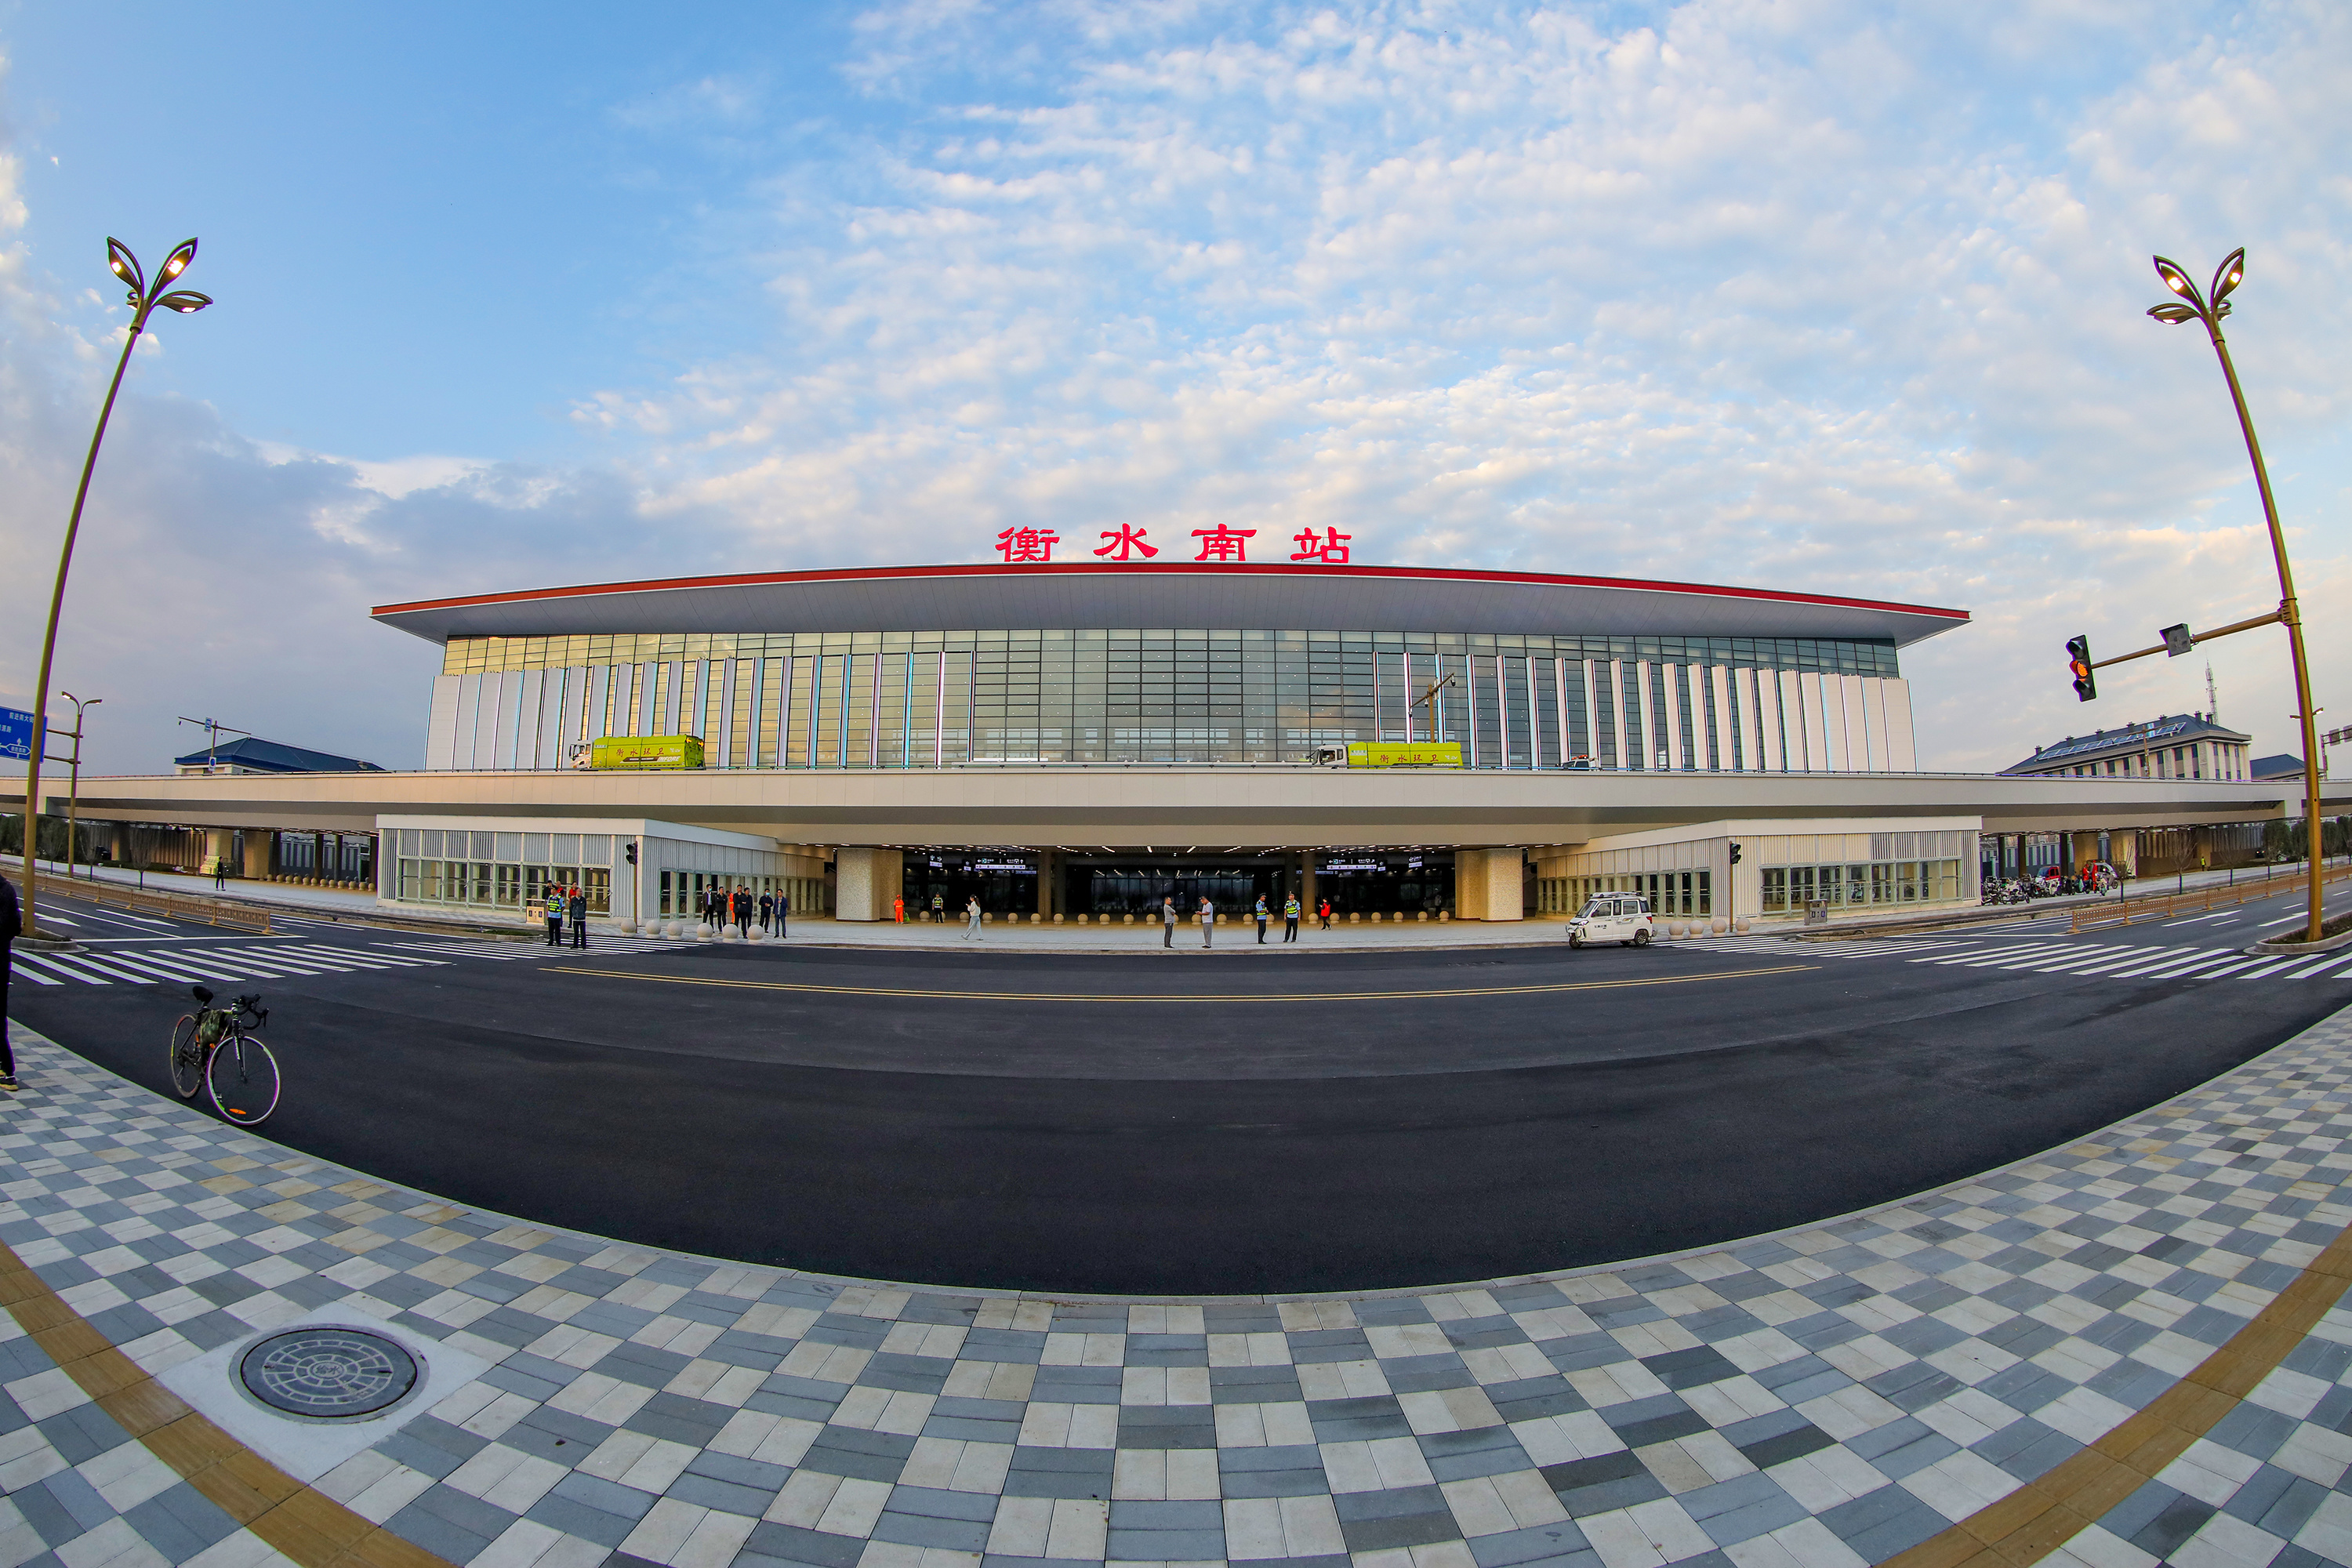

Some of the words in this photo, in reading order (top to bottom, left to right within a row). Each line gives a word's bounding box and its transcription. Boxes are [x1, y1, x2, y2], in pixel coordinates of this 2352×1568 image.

[995, 523, 1352, 563] 衡水南站
[616, 747, 664, 757] 衡水环卫
[1380, 754, 1439, 764] 衡水环卫
